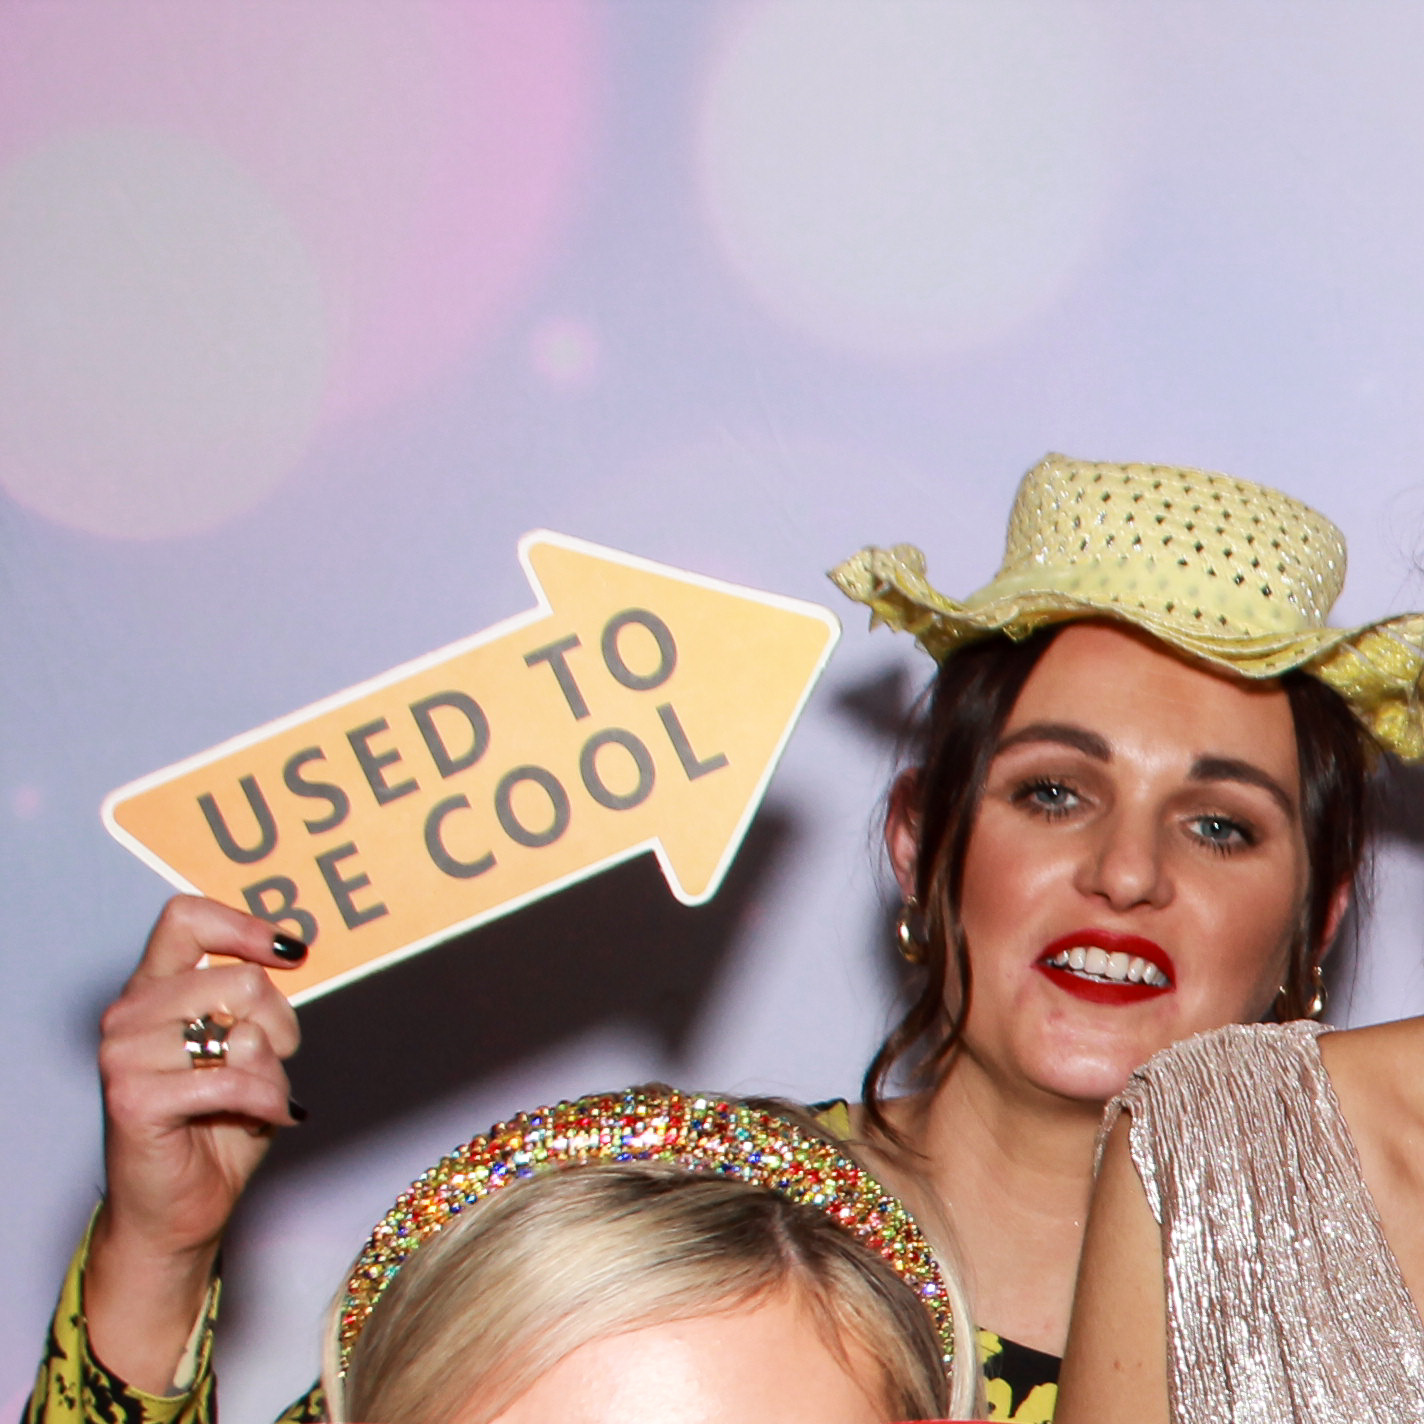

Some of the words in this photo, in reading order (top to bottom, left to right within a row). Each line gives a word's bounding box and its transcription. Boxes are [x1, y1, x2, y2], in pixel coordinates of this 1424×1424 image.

[197, 690, 491, 864] USED
[524, 607, 677, 721] TO
[241, 841, 389, 947] BE
[424, 702, 729, 879] COOL
